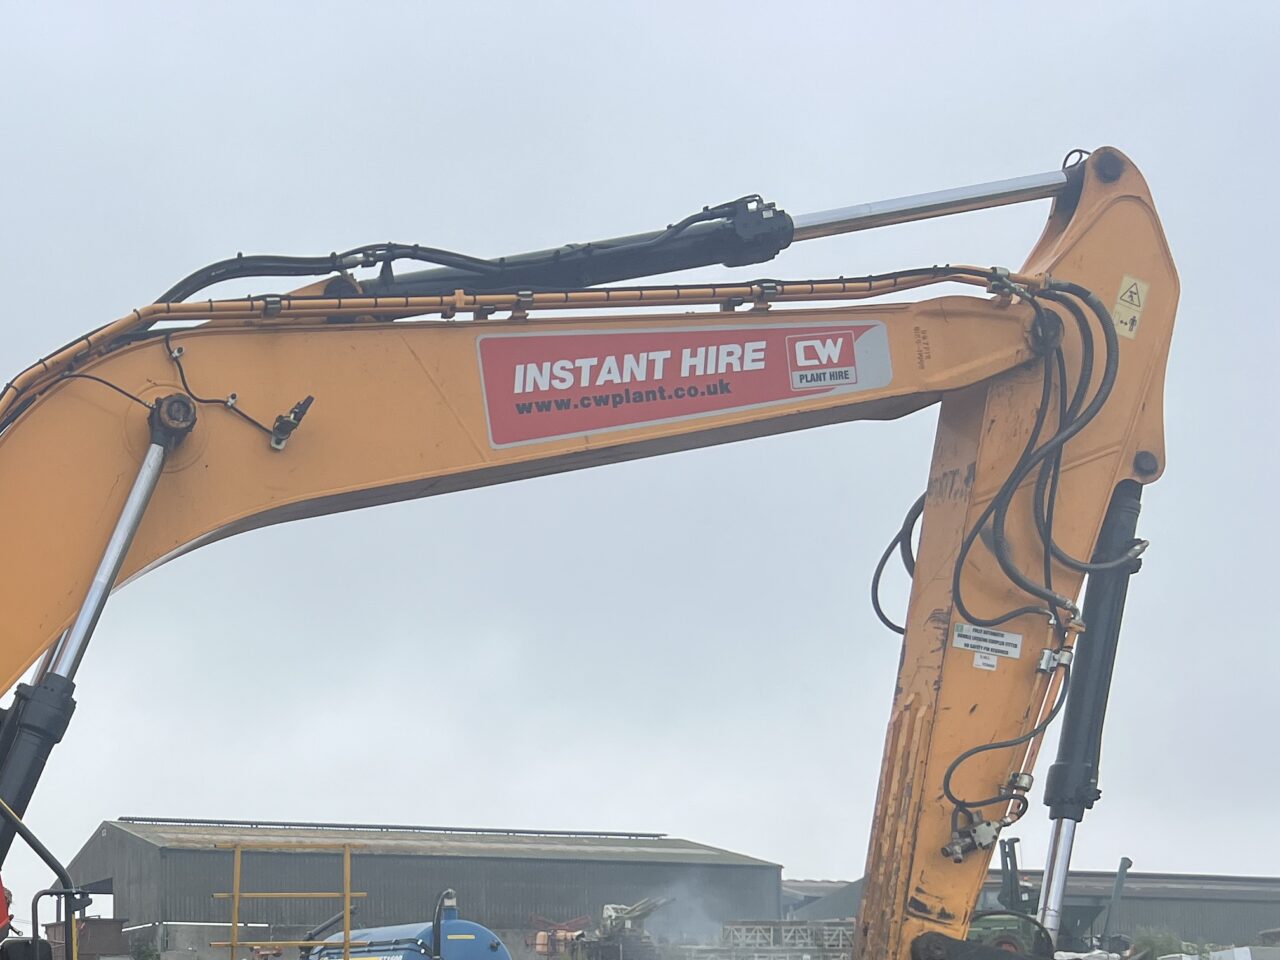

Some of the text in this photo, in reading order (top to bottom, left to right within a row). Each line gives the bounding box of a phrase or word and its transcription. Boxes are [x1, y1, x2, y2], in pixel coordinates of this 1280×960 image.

[513, 341, 767, 394] INSTANT HIRE
[795, 337, 844, 367] CW
[799, 370, 850, 384] PLANT HIRE
[515, 379, 732, 415] www.cwplant.co.uk
